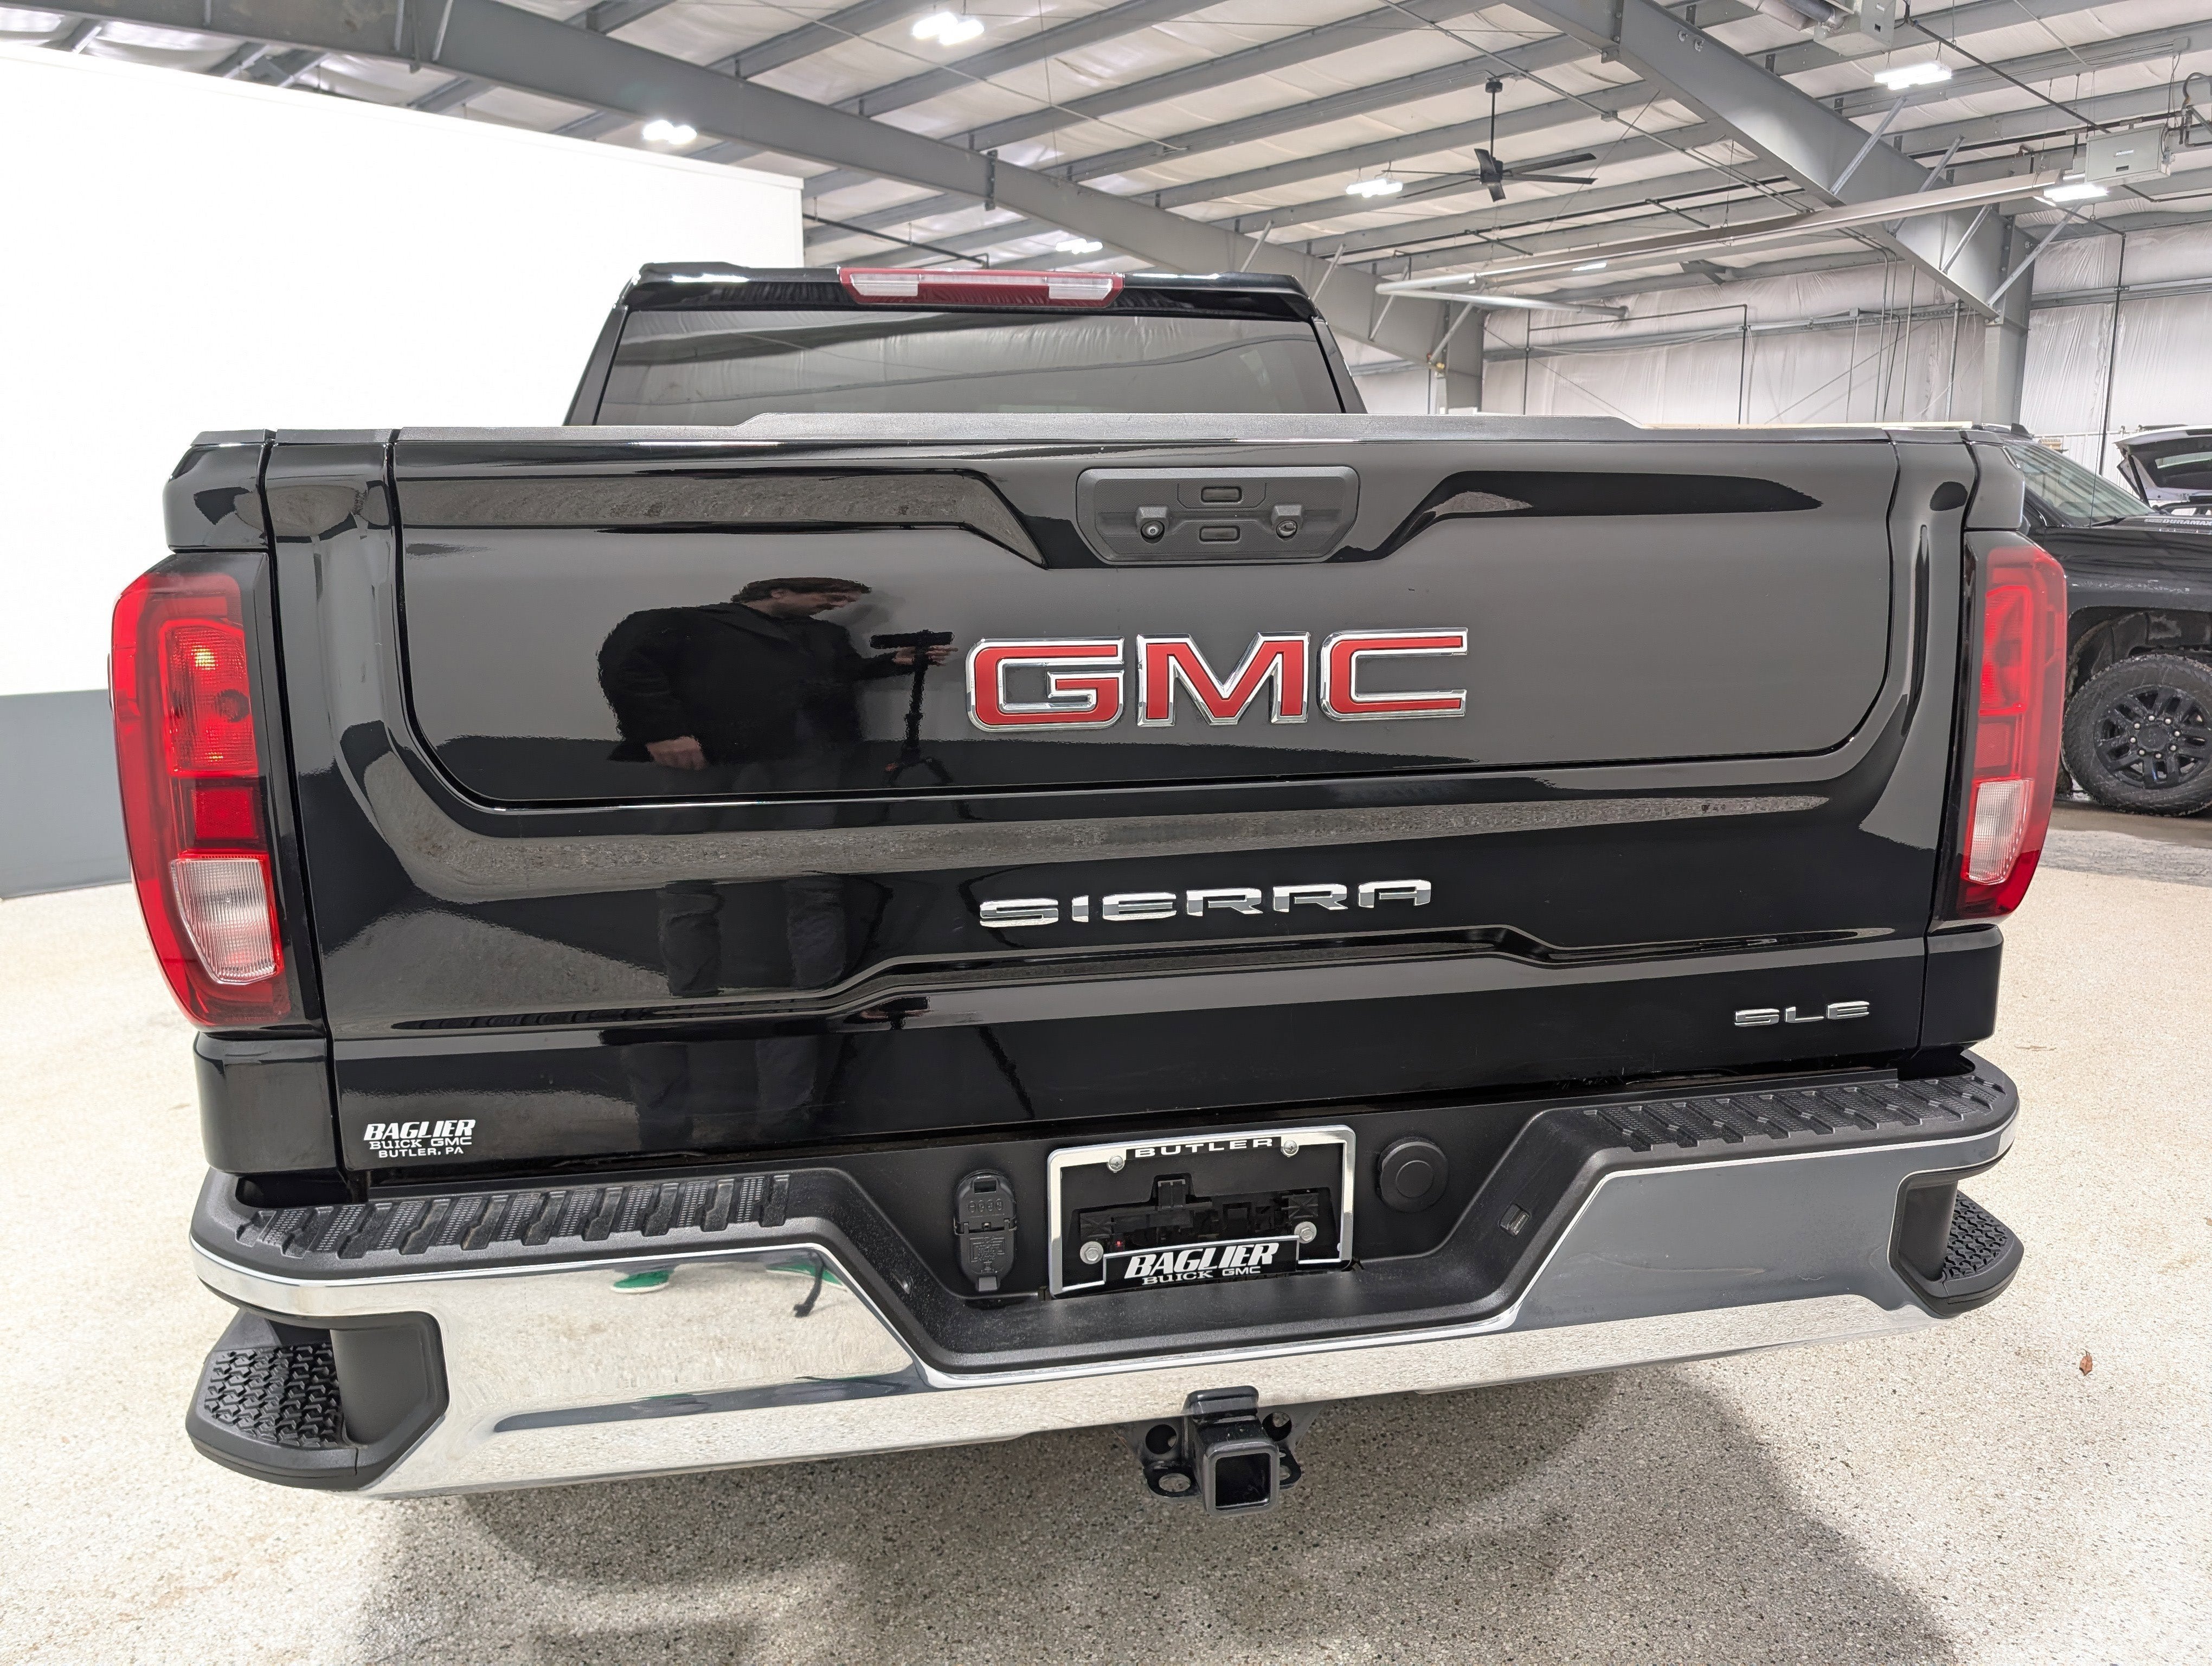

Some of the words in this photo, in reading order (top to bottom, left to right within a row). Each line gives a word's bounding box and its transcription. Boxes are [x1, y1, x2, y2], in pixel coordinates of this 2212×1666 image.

[966, 627, 1468, 732] GMC
[979, 879, 1432, 927] SIERRA
[1734, 1001, 1870, 1027] SLE
[363, 1119, 476, 1141] BAGLIER
[369, 1139, 422, 1150] BUICK
[430, 1136, 472, 1147] GMC
[378, 1148, 441, 1158] BUTLER,
[446, 1146, 464, 1155] PA
[1135, 1138, 1272, 1158] BUTLER
[1124, 1242, 1279, 1279] BAGLIER
[1141, 1270, 1214, 1286] BUICK
[1221, 1266, 1261, 1277] GMC
